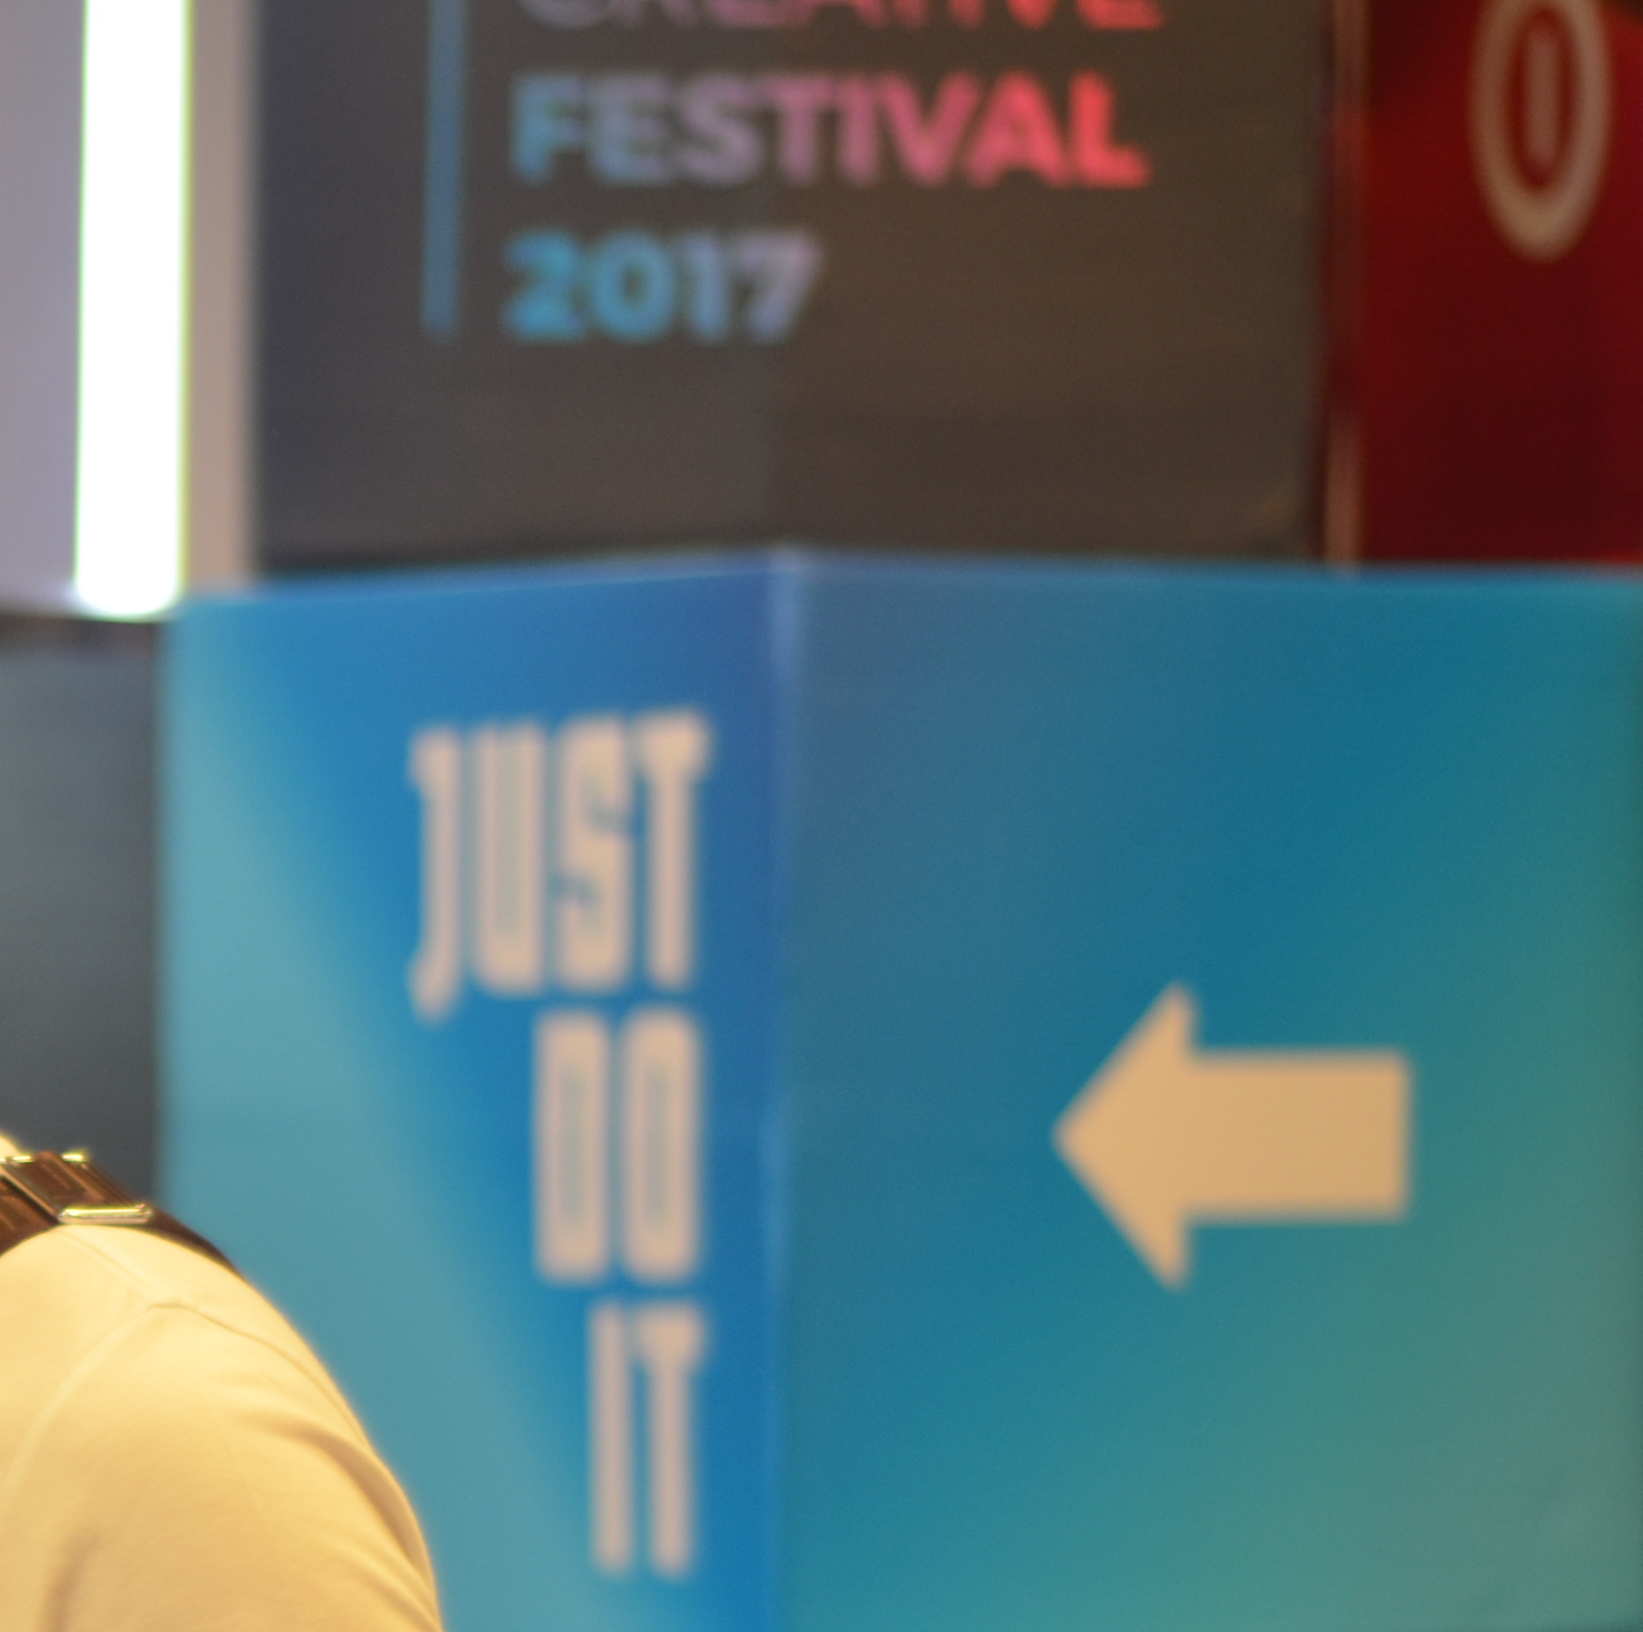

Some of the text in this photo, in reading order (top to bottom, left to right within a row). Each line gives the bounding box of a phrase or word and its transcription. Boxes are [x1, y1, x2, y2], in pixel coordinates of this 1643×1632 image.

[511, 72, 1150, 186] FESTIVAL
[505, 230, 821, 342] 2017
[409, 707, 713, 1024] JUST
[535, 1005, 702, 1284] DO
[591, 1298, 707, 1578] IT
